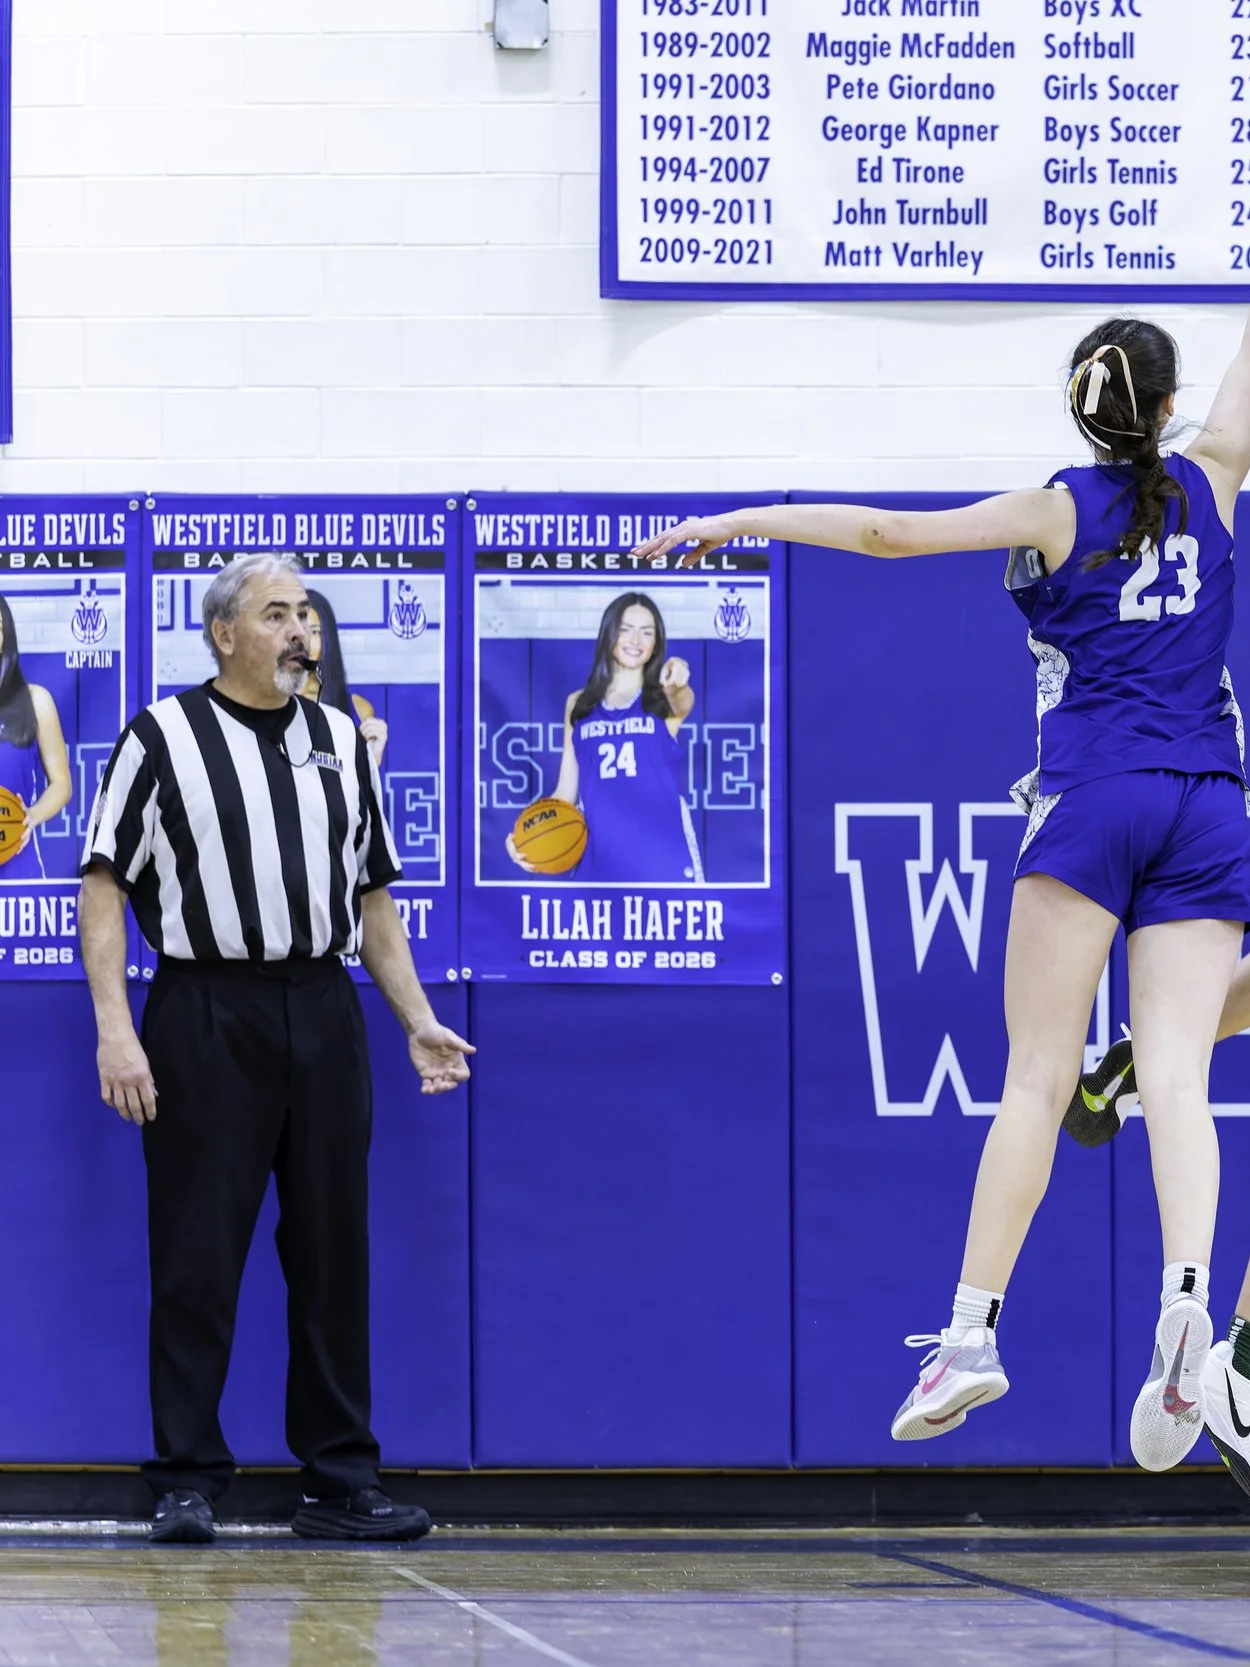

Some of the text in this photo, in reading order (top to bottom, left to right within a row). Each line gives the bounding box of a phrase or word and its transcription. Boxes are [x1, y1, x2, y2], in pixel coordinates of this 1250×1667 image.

[843, 0, 980, 17] Jack Martin
[1044, 0, 1142, 25] Boys XC
[641, 32, 771, 58] 1989-2002
[806, 32, 1016, 66] Maggie McFadden
[1043, 31, 1135, 59] Softball
[641, 74, 771, 100] 1991-2003
[826, 73, 996, 101] Pete Giordano
[1043, 74, 1180, 102] Girls Soccer
[641, 115, 771, 142] 1991-2012
[821, 115, 999, 150] George Kapner
[1044, 116, 1182, 150] Boys Soccer
[641, 156, 770, 183] 1994-2007
[857, 157, 965, 184] Ed Tirone
[1043, 157, 1178, 185] Girls Tennis
[641, 198, 772, 225] 1999-2011
[833, 198, 988, 226] John Turnbull
[1044, 199, 1158, 233] Boys Golf
[639, 238, 773, 265] 2009-2021
[825, 240, 983, 275] Matt Varhley
[1040, 242, 1176, 270] Girls Tennis
[0, 514, 125, 546] UE DEVILS
[152, 514, 445, 546] WESTFIELD BLUE DEVILS
[474, 515, 611, 547] WESTFIELD
[0, 552, 94, 568] BALL
[184, 552, 413, 569] BATBALL
[1119, 533, 1202, 621] 23
[65, 652, 113, 669] CAPTAIN
[580, 716, 655, 741] WESTFIELD
[598, 741, 637, 780] 24
[523, 808, 558, 834] NCAA
[520, 894, 725, 941] LILAH HAFER
[14, 947, 74, 965] 2026
[529, 950, 717, 969] CLASS OF 2026
